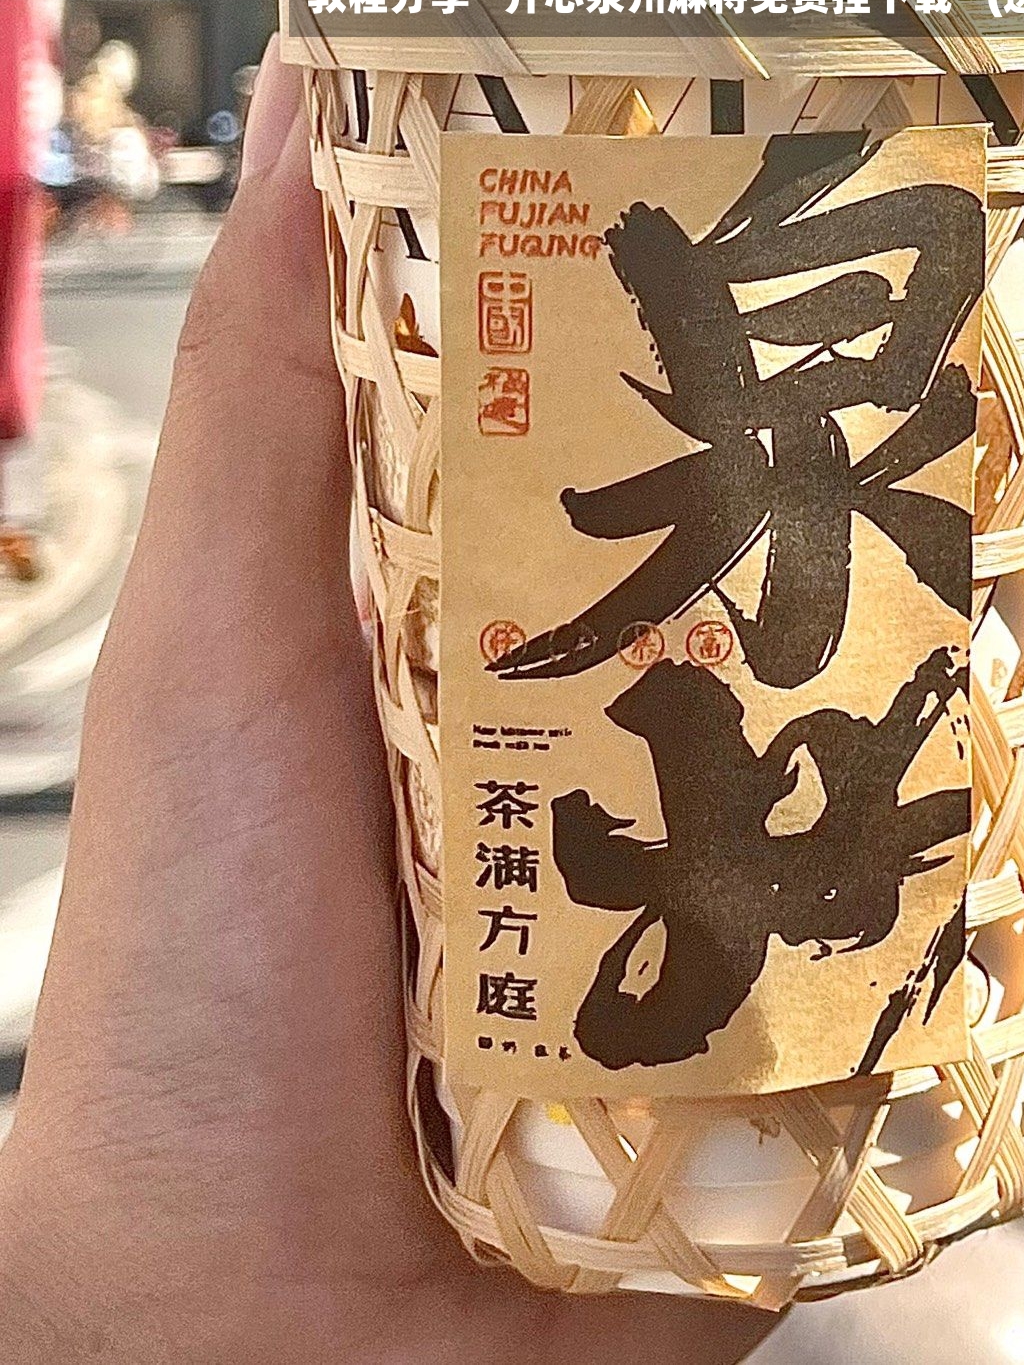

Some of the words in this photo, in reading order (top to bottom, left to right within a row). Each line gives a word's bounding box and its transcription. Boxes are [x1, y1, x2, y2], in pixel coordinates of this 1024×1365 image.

[478, 167, 573, 195] CHINA
[479, 200, 590, 229] FUJIAN
[478, 232, 602, 260] FUQING
[473, 780, 540, 1021] 茶满方庭
